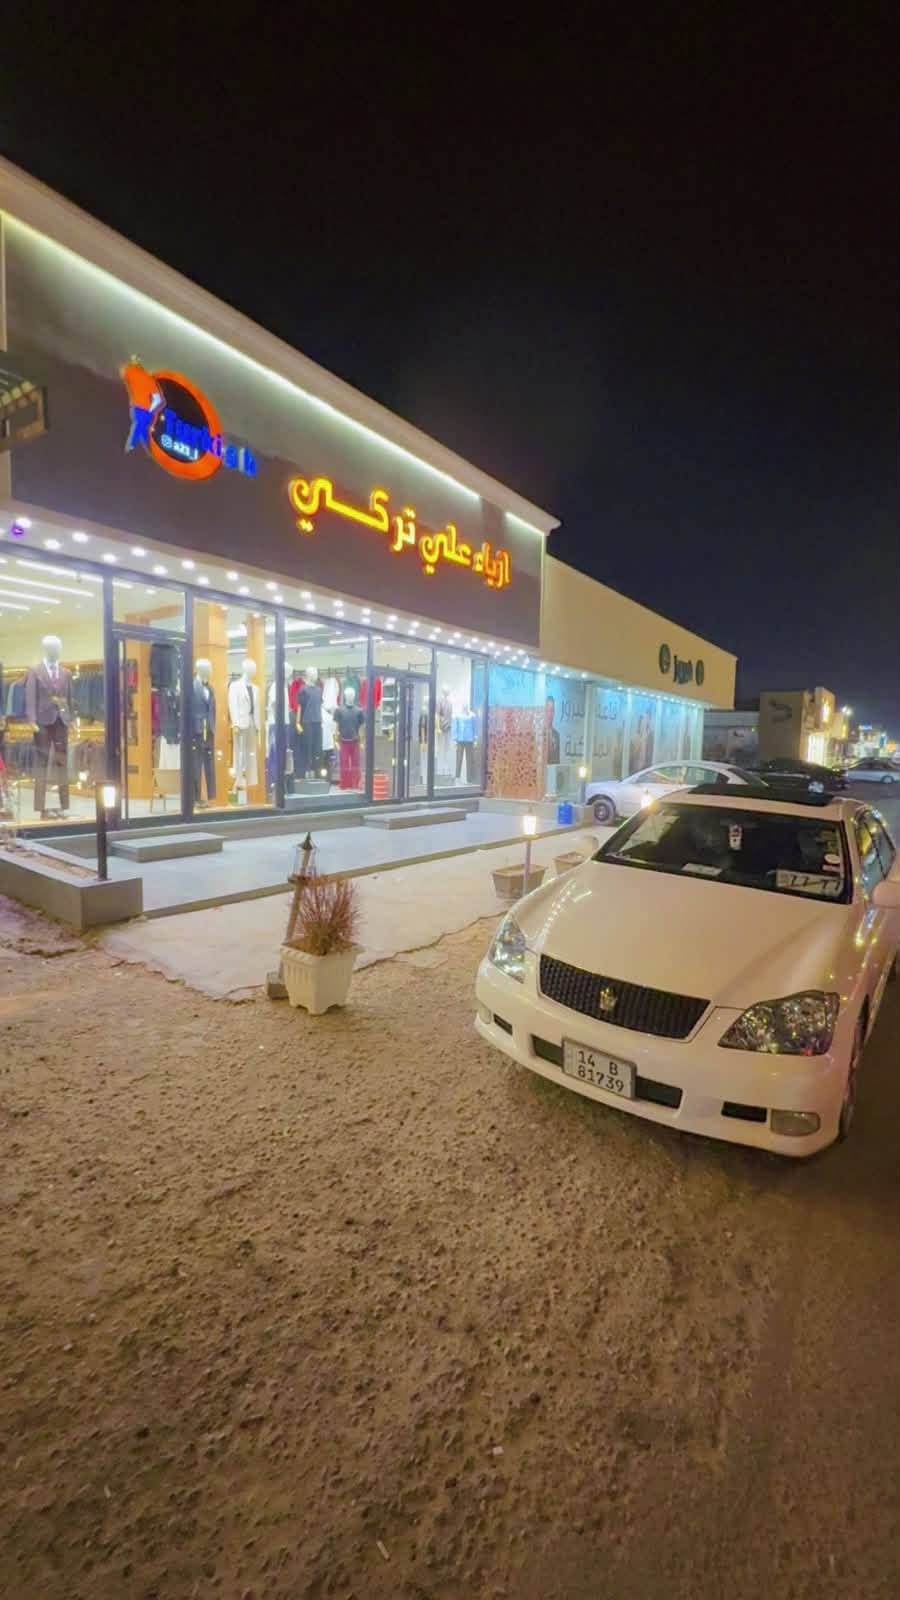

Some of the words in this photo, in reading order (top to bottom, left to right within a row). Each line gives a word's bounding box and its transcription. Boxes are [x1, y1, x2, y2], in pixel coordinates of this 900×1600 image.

[419, 523, 472, 575] علي
[577, 1050, 595, 1067] 14
[609, 1061, 618, 1076] B
[578, 1065, 624, 1092] 81739
